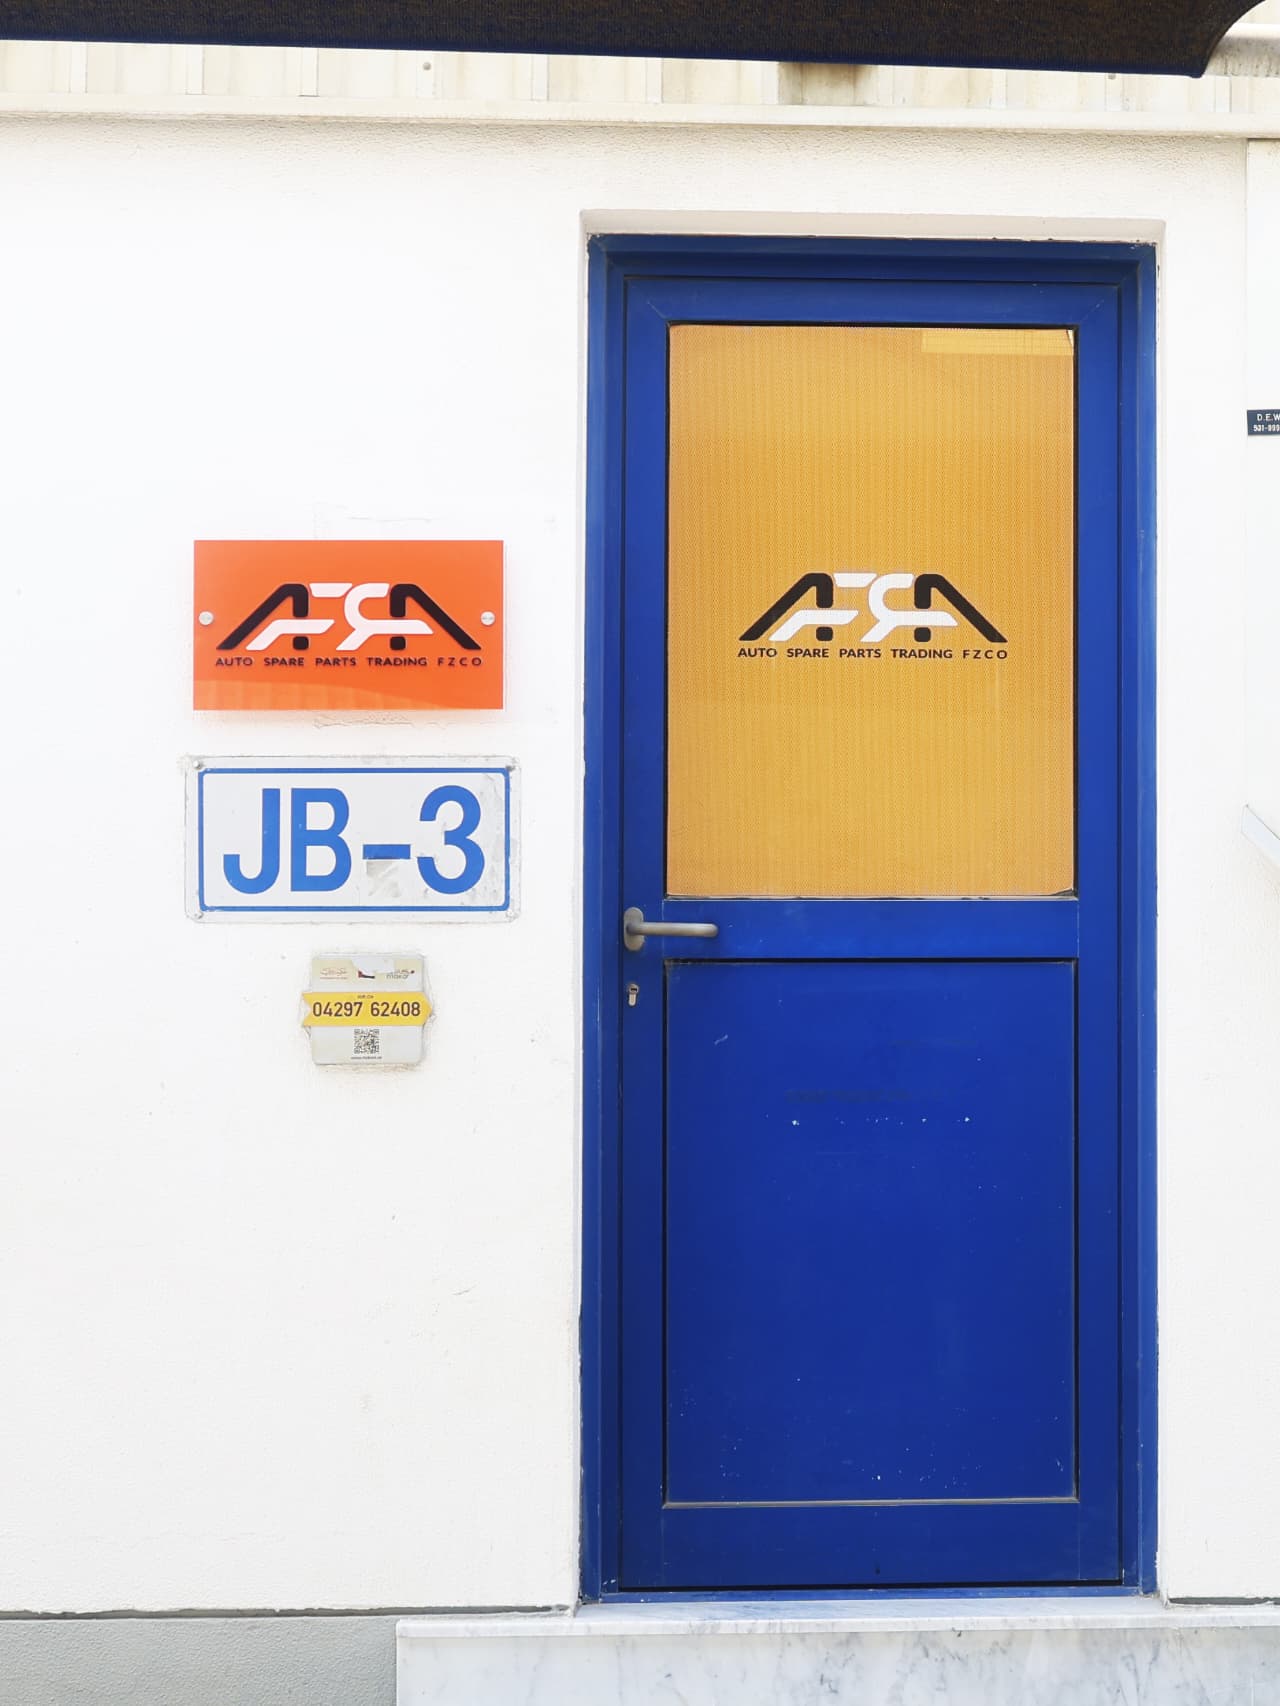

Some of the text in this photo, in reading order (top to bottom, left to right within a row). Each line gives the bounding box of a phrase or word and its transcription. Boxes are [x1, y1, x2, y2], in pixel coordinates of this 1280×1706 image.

[738, 647, 778, 658] AUTO
[786, 648, 830, 658] SPARE
[839, 648, 882, 659] PARTS
[891, 648, 953, 659] TRADING
[215, 656, 253, 667] AUTO
[263, 656, 304, 667] SPARE
[315, 656, 357, 667] PARTS
[367, 656, 427, 667] TRADING
[223, 785, 485, 895] JB-3
[312, 1001, 421, 1017] 04297 62408
